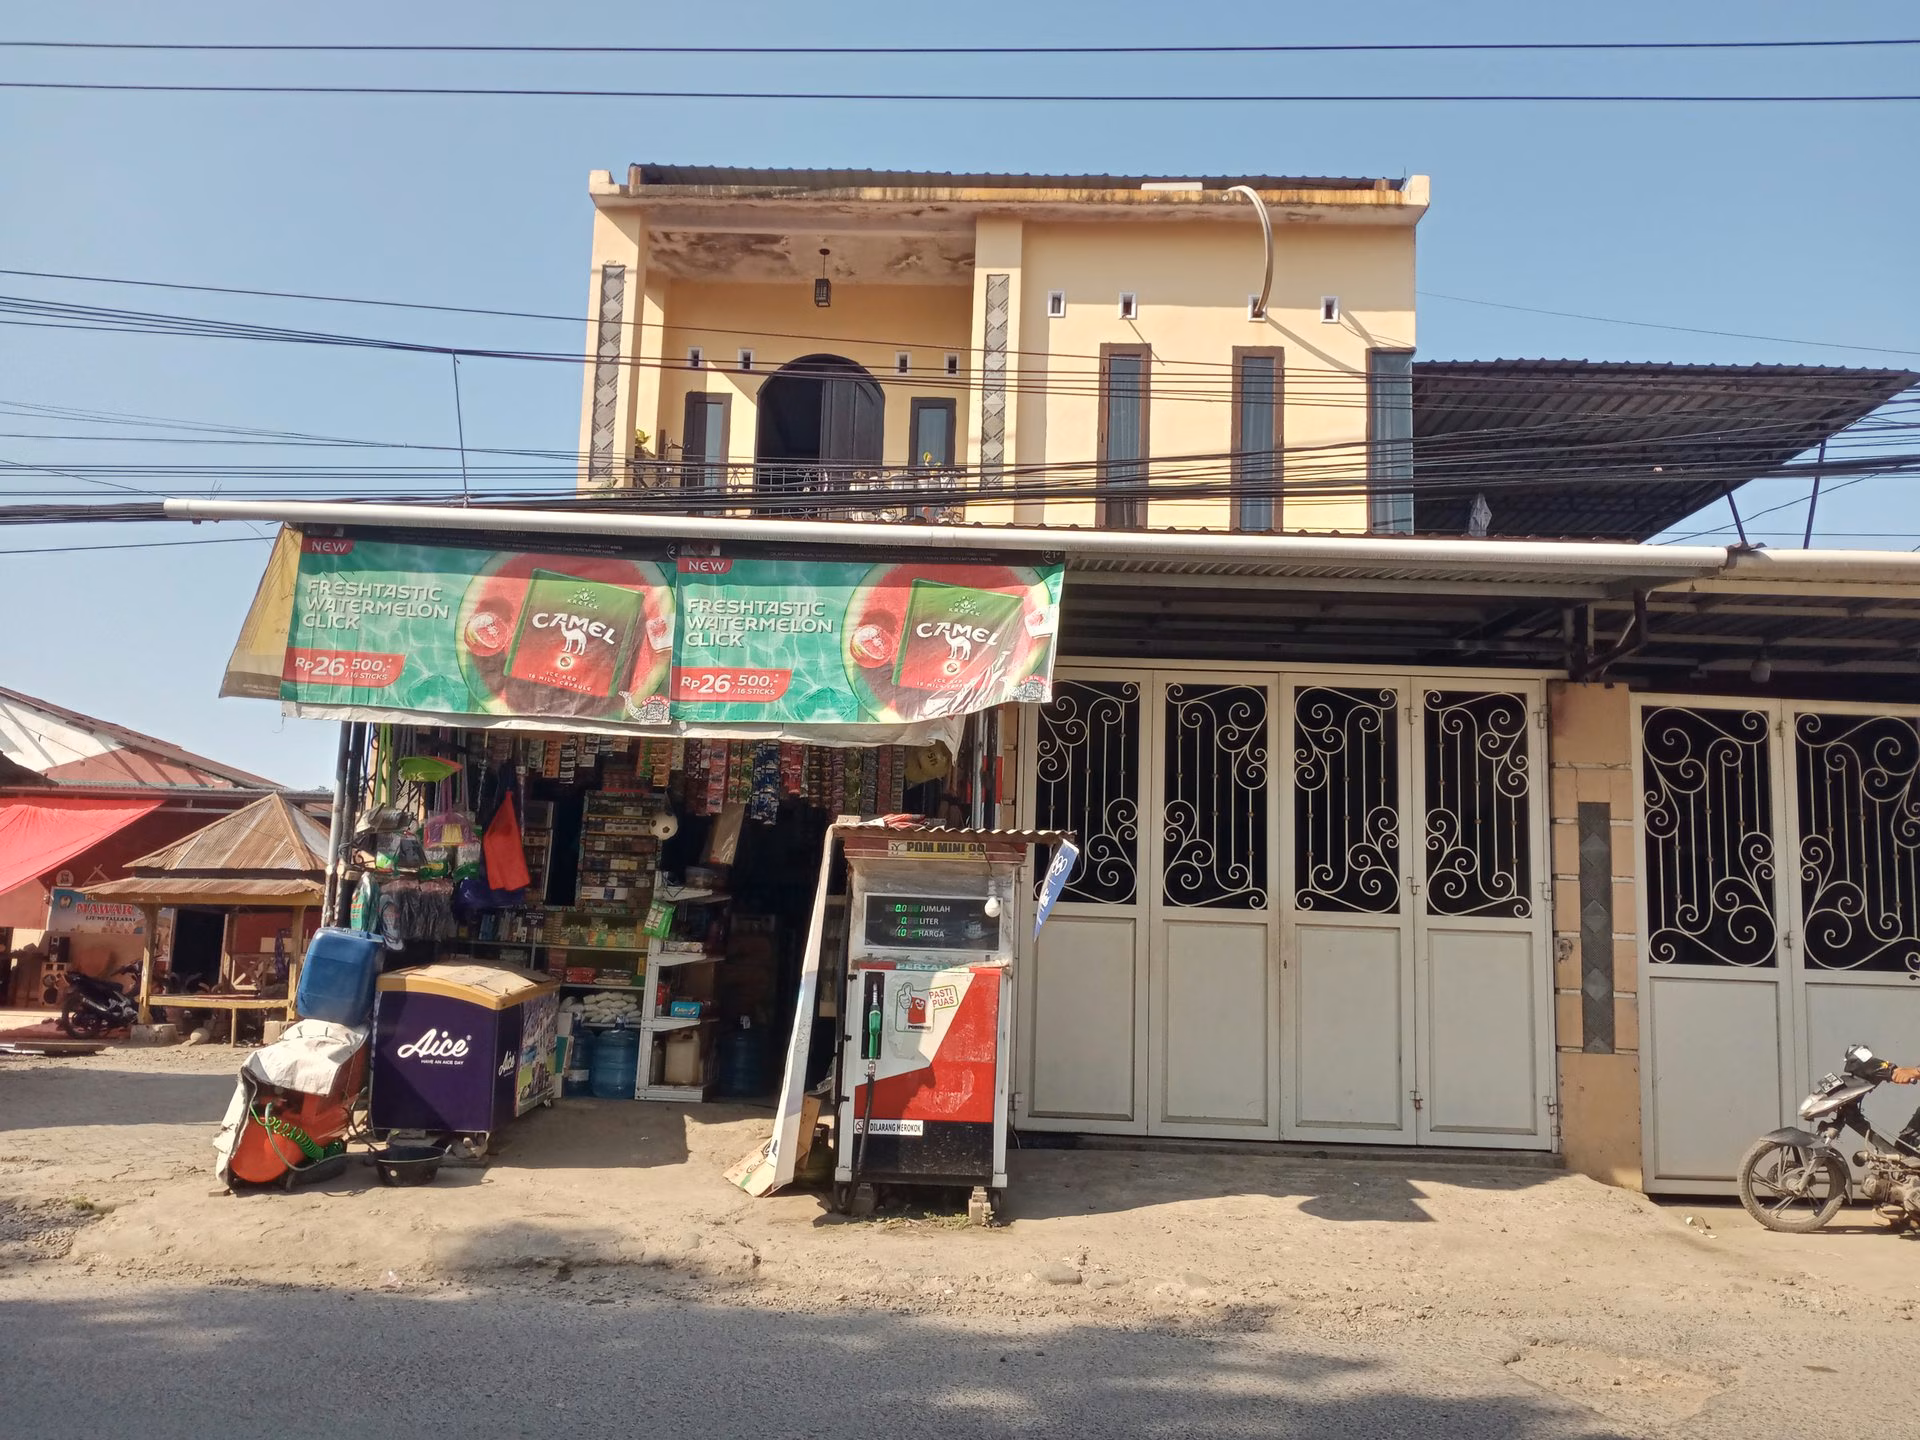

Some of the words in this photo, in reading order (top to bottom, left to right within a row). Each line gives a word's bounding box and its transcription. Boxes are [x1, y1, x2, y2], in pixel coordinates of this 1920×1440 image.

[311, 540, 347, 553] NEW
[688, 560, 725, 572] NEW
[306, 579, 443, 602] FRESHTASTIC
[304, 596, 450, 619] WATERMELON
[687, 598, 826, 617] FRESHTASTIC
[302, 614, 361, 630] CLICK
[532, 612, 616, 645] CAMEL
[686, 615, 834, 633] WATERMELON
[685, 633, 745, 648] CLICK
[916, 622, 1000, 646] CAMEL
[359, 672, 388, 680] STICKS
[559, 679, 592, 691] CAPSULE
[906, 841, 934, 853] POM
[937, 842, 966, 853] MINI
[76, 902, 134, 915] MAWAR
[919, 905, 951, 913] JUMLAH
[919, 917, 939, 925] LITER
[918, 929, 945, 938] HARGA
[932, 997, 955, 1008] PUAS
[397, 1028, 470, 1059] Aice
[870, 1123, 896, 1132] DILARANG
[897, 1123, 922, 1133] MEROKOK
